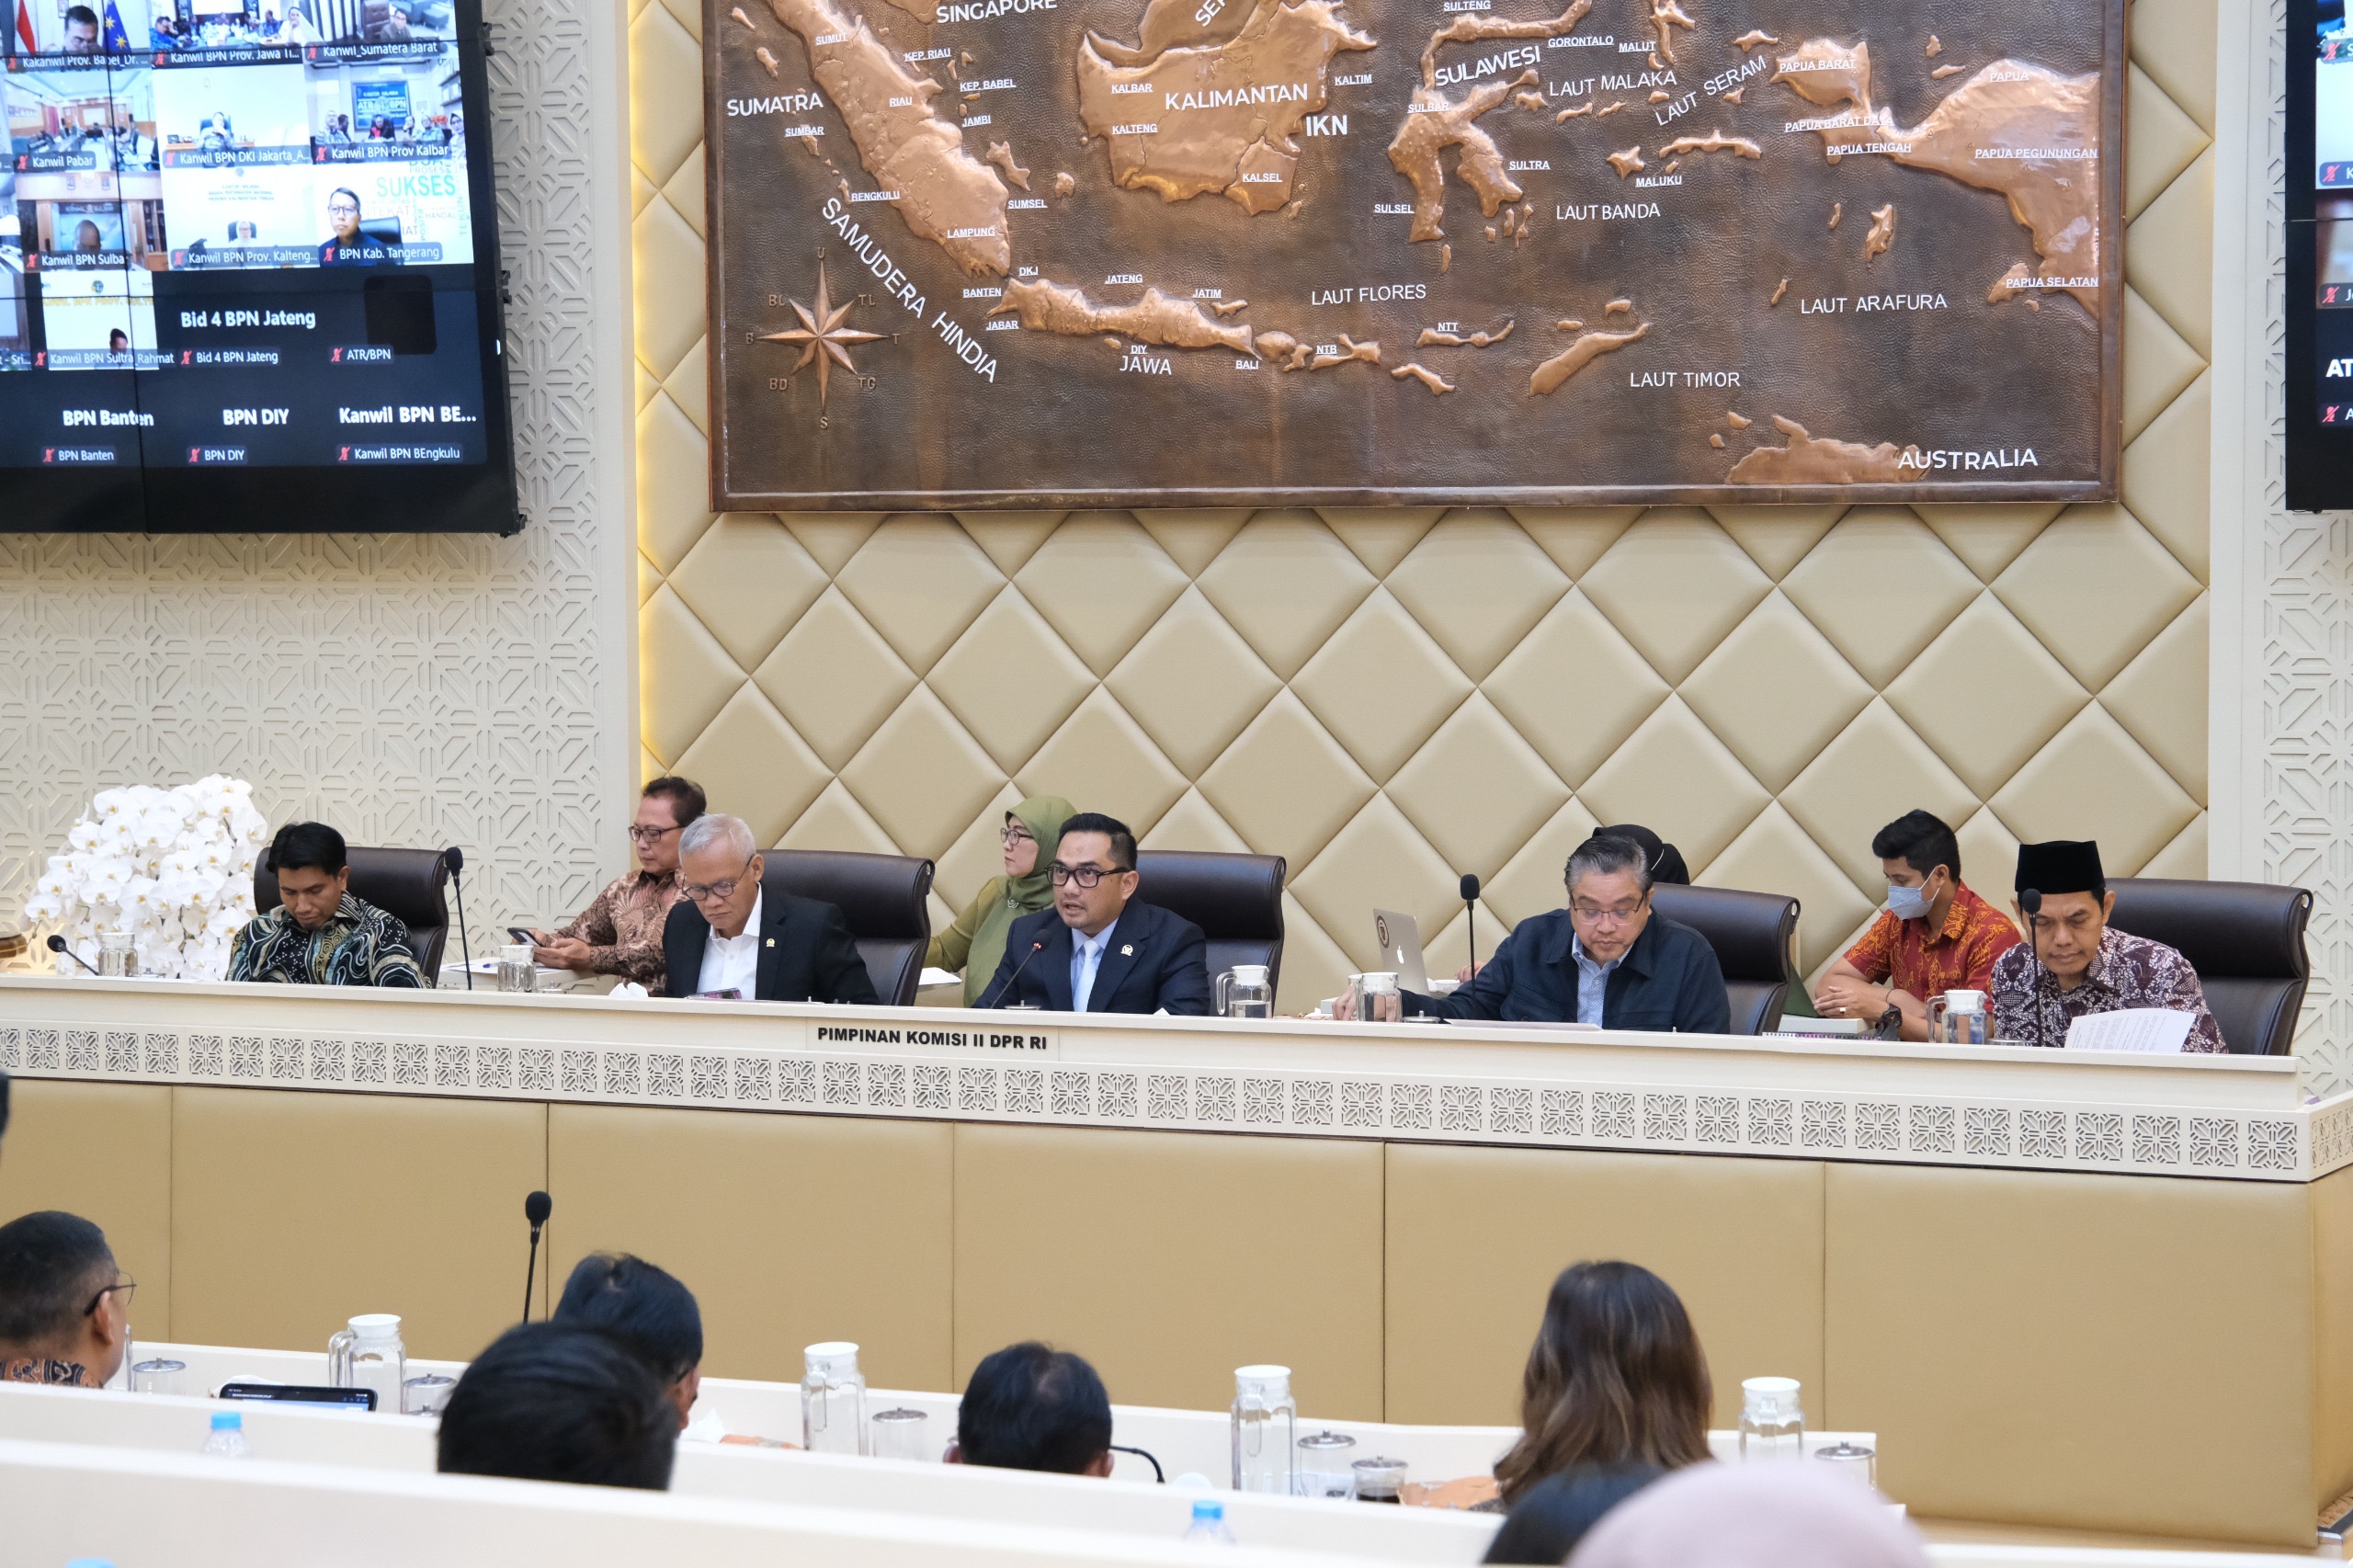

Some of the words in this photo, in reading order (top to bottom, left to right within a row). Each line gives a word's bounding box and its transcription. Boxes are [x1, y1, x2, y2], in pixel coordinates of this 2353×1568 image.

[1444, 0, 1491, 11] SULTENG
[815, 33, 847, 44] SUMUT
[1548, 36, 1614, 48] GORONTALO
[411, 41, 438, 53] Barat
[1619, 41, 1656, 52] MALUT
[67, 55, 91, 66] Prov.
[171, 51, 203, 62] Kanwil
[206, 51, 227, 62] BPN
[230, 50, 255, 61] Prov.
[256, 49, 280, 60] Jawa
[904, 51, 926, 62] KEP.
[928, 48, 951, 60] RIAU
[1435, 46, 1541, 87] SULAWESI
[1779, 62, 1816, 73] PAPUA
[1818, 59, 1857, 70] BARAT
[1335, 74, 1372, 85] KALTIM
[1989, 72, 2029, 82] PAPUA
[960, 82, 981, 92] KEP.
[983, 79, 1016, 90] BABEL
[1111, 83, 1153, 94] KALBAR
[1550, 79, 1596, 97] LAUT
[1601, 71, 1677, 91] MALAKA
[1165, 83, 1308, 110] KALIMANTAN
[1655, 92, 1698, 127] LAUT
[1703, 55, 1768, 97] SERAM
[727, 92, 824, 117] SUMATRA
[890, 97, 913, 107] RIAU
[1407, 102, 1449, 113] SULBAR
[962, 116, 991, 127] JAMBI
[1306, 115, 1347, 137] IKN
[1784, 122, 1822, 132] PAPUA
[1824, 119, 1861, 130] BARAT
[1863, 116, 1893, 127] DAYA
[785, 126, 824, 137] SUMBAR
[1112, 124, 1158, 134] KALTENG
[332, 146, 365, 159] Kanwil
[368, 146, 388, 157] BPN
[392, 145, 414, 157] Prov
[416, 144, 449, 156] Kalbar
[1826, 145, 1864, 155] PAPUA
[1865, 142, 1912, 153] TENGAH
[1975, 149, 2013, 158] PAPUA
[2016, 148, 2098, 158] PEGUNUNGAN
[32, 155, 64, 167] Kanwil
[66, 155, 93, 166] Pabar
[180, 152, 212, 164] Kanwil
[215, 152, 236, 163] BPN
[239, 152, 256, 162] DKI
[1508, 161, 1551, 170] SULTRA
[1243, 173, 1282, 183] KALSEL
[1636, 176, 1682, 187] MALUKU
[376, 175, 456, 197] SUKSES
[850, 190, 900, 201] BENGKULU
[1007, 199, 1048, 209] SUMSEL
[1373, 204, 1415, 213] SULSEL
[1556, 205, 1598, 221] LAUT
[1602, 203, 1661, 220] BANDA
[947, 227, 995, 238] LAMPUNG
[188, 251, 221, 264] Kanwil
[223, 252, 244, 263] BPN
[246, 251, 271, 262] Prov.
[339, 248, 361, 260] BPN
[363, 248, 384, 259] Kab.
[387, 247, 439, 260] Tangerang
[817, 247, 825, 259] U
[41, 254, 73, 266] Kanwil
[76, 256, 96, 266] BPN
[98, 254, 129, 265] Sulba
[1019, 267, 1039, 276] DKJ
[1105, 274, 1143, 284] JATENG
[2006, 278, 2044, 288] PAPUA
[2047, 277, 2098, 287] SELATAN
[822, 198, 926, 318] SAMUDERA
[931, 312, 998, 382] HINDIA
[963, 287, 1002, 298] BANTEN
[1193, 289, 1222, 299] JATIM
[1312, 289, 1353, 305] LAUT
[1359, 284, 1427, 302] FLORES
[768, 294, 786, 307] BL
[858, 294, 876, 306] TL
[1801, 298, 1848, 314] LAUT
[1856, 293, 1948, 312] ARAFURA
[181, 312, 207, 328] Bid
[211, 312, 222, 326] 4
[225, 311, 259, 326] BPN
[263, 311, 316, 329] Jateng
[985, 321, 1019, 331] JABAR
[1438, 323, 1459, 332] NTT
[745, 333, 755, 345] B
[892, 333, 901, 345] T
[347, 349, 392, 361] ATR/BPN
[1131, 346, 1147, 355] DIY
[1316, 345, 1337, 355] NTB
[50, 353, 82, 364] Kanwil
[85, 354, 105, 363] BPN
[196, 352, 211, 363] Bid
[214, 353, 222, 362] 4
[223, 352, 244, 362] BPN
[245, 351, 278, 364] Jateng
[1120, 356, 1172, 375] JAWA
[1236, 360, 1259, 369] BALI
[858, 377, 876, 390] TG
[1631, 372, 1677, 387] LAUT
[1683, 372, 1741, 388] TIMOR
[63, 410, 97, 426] BPN
[99, 409, 154, 426] Banten
[223, 410, 257, 425] BPN
[261, 409, 290, 424] DIY
[339, 406, 392, 423] Kanwil
[400, 406, 435, 422] BPN
[820, 417, 828, 429] S
[58, 450, 78, 460] BPN
[81, 449, 114, 460] Banten
[204, 449, 225, 460] BPN
[228, 449, 244, 460] DIY
[355, 448, 387, 459] Kanwil
[390, 449, 411, 459] BPN
[414, 448, 460, 460] BEngkulu
[1898, 449, 2038, 470] AUSTRALIA
[818, 1028, 901, 1043] PIMPINAN
[907, 1031, 966, 1046] KOMISI
[973, 1034, 983, 1047] II
[990, 1035, 1024, 1048] DPR
[1029, 1036, 1047, 1050] RI
